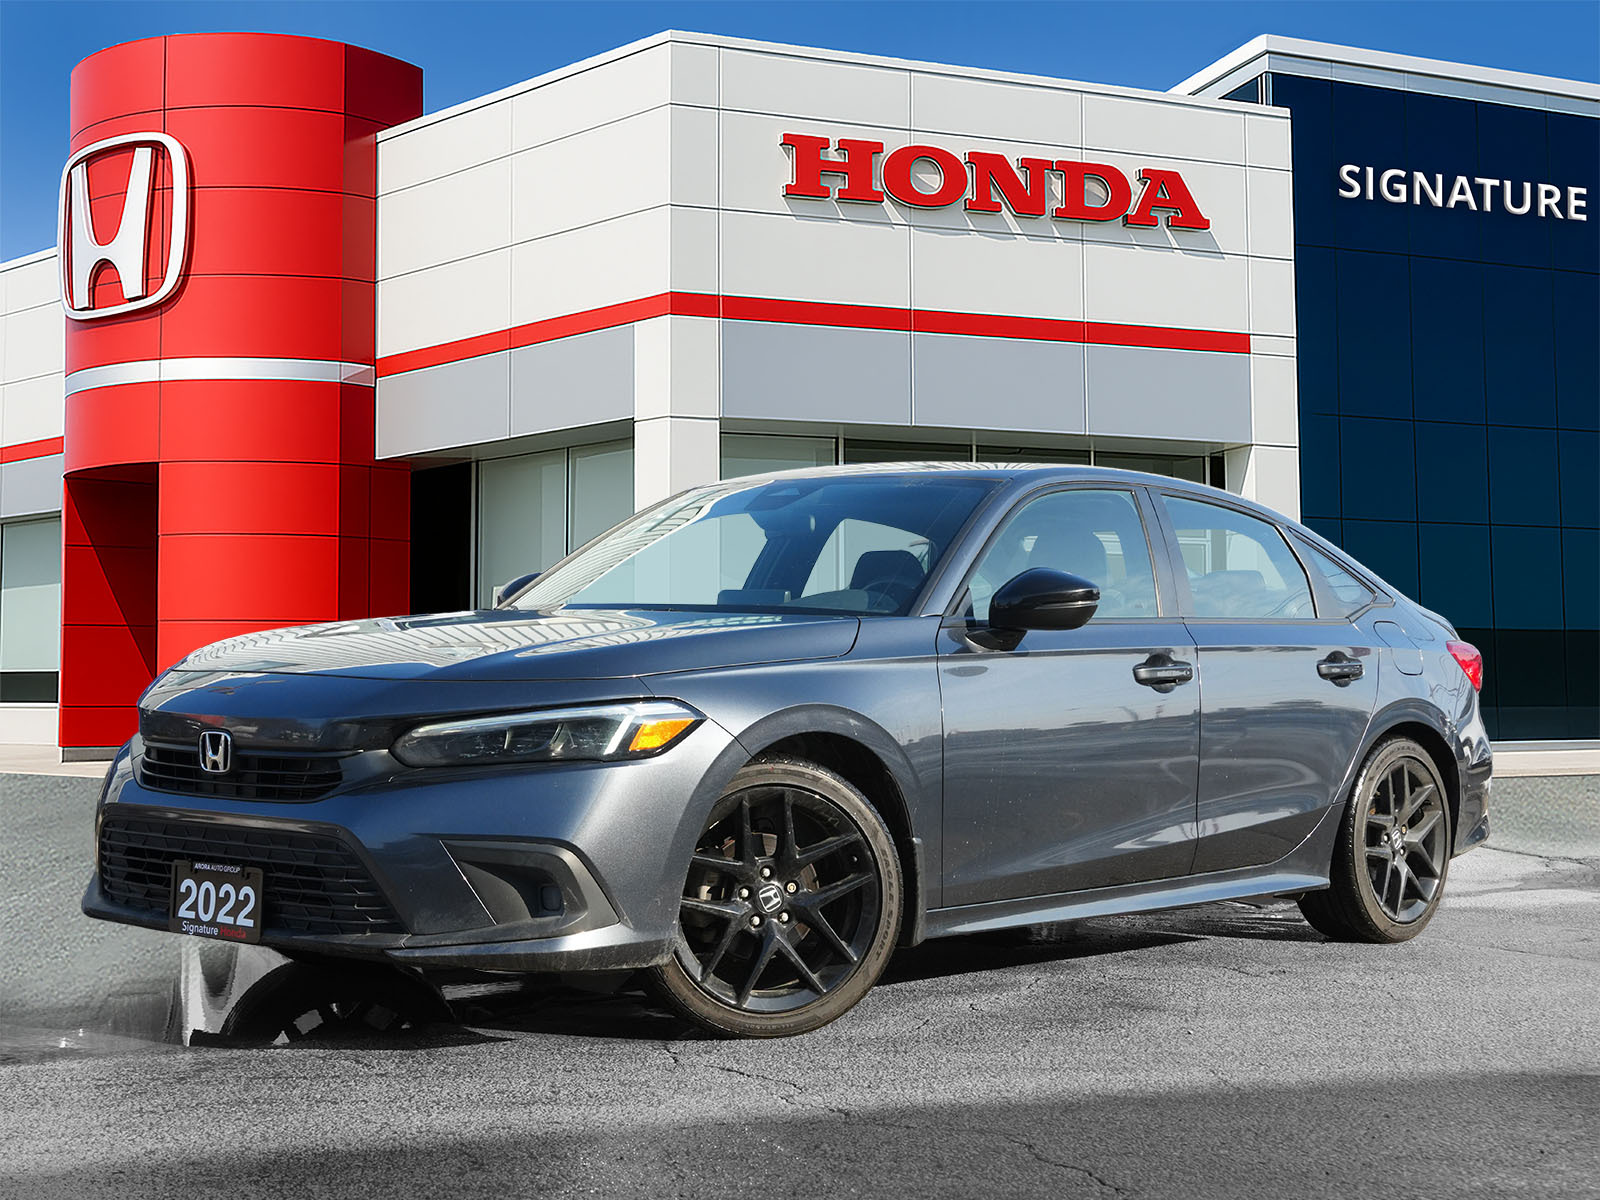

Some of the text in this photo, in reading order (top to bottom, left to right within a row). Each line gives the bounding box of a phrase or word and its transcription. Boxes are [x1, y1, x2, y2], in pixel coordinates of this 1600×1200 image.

[780, 133, 1210, 230] HONDA
[1338, 164, 1588, 221] SIGNATURE
[178, 879, 255, 928] 2022
[182, 921, 246, 938] Signature Honda
